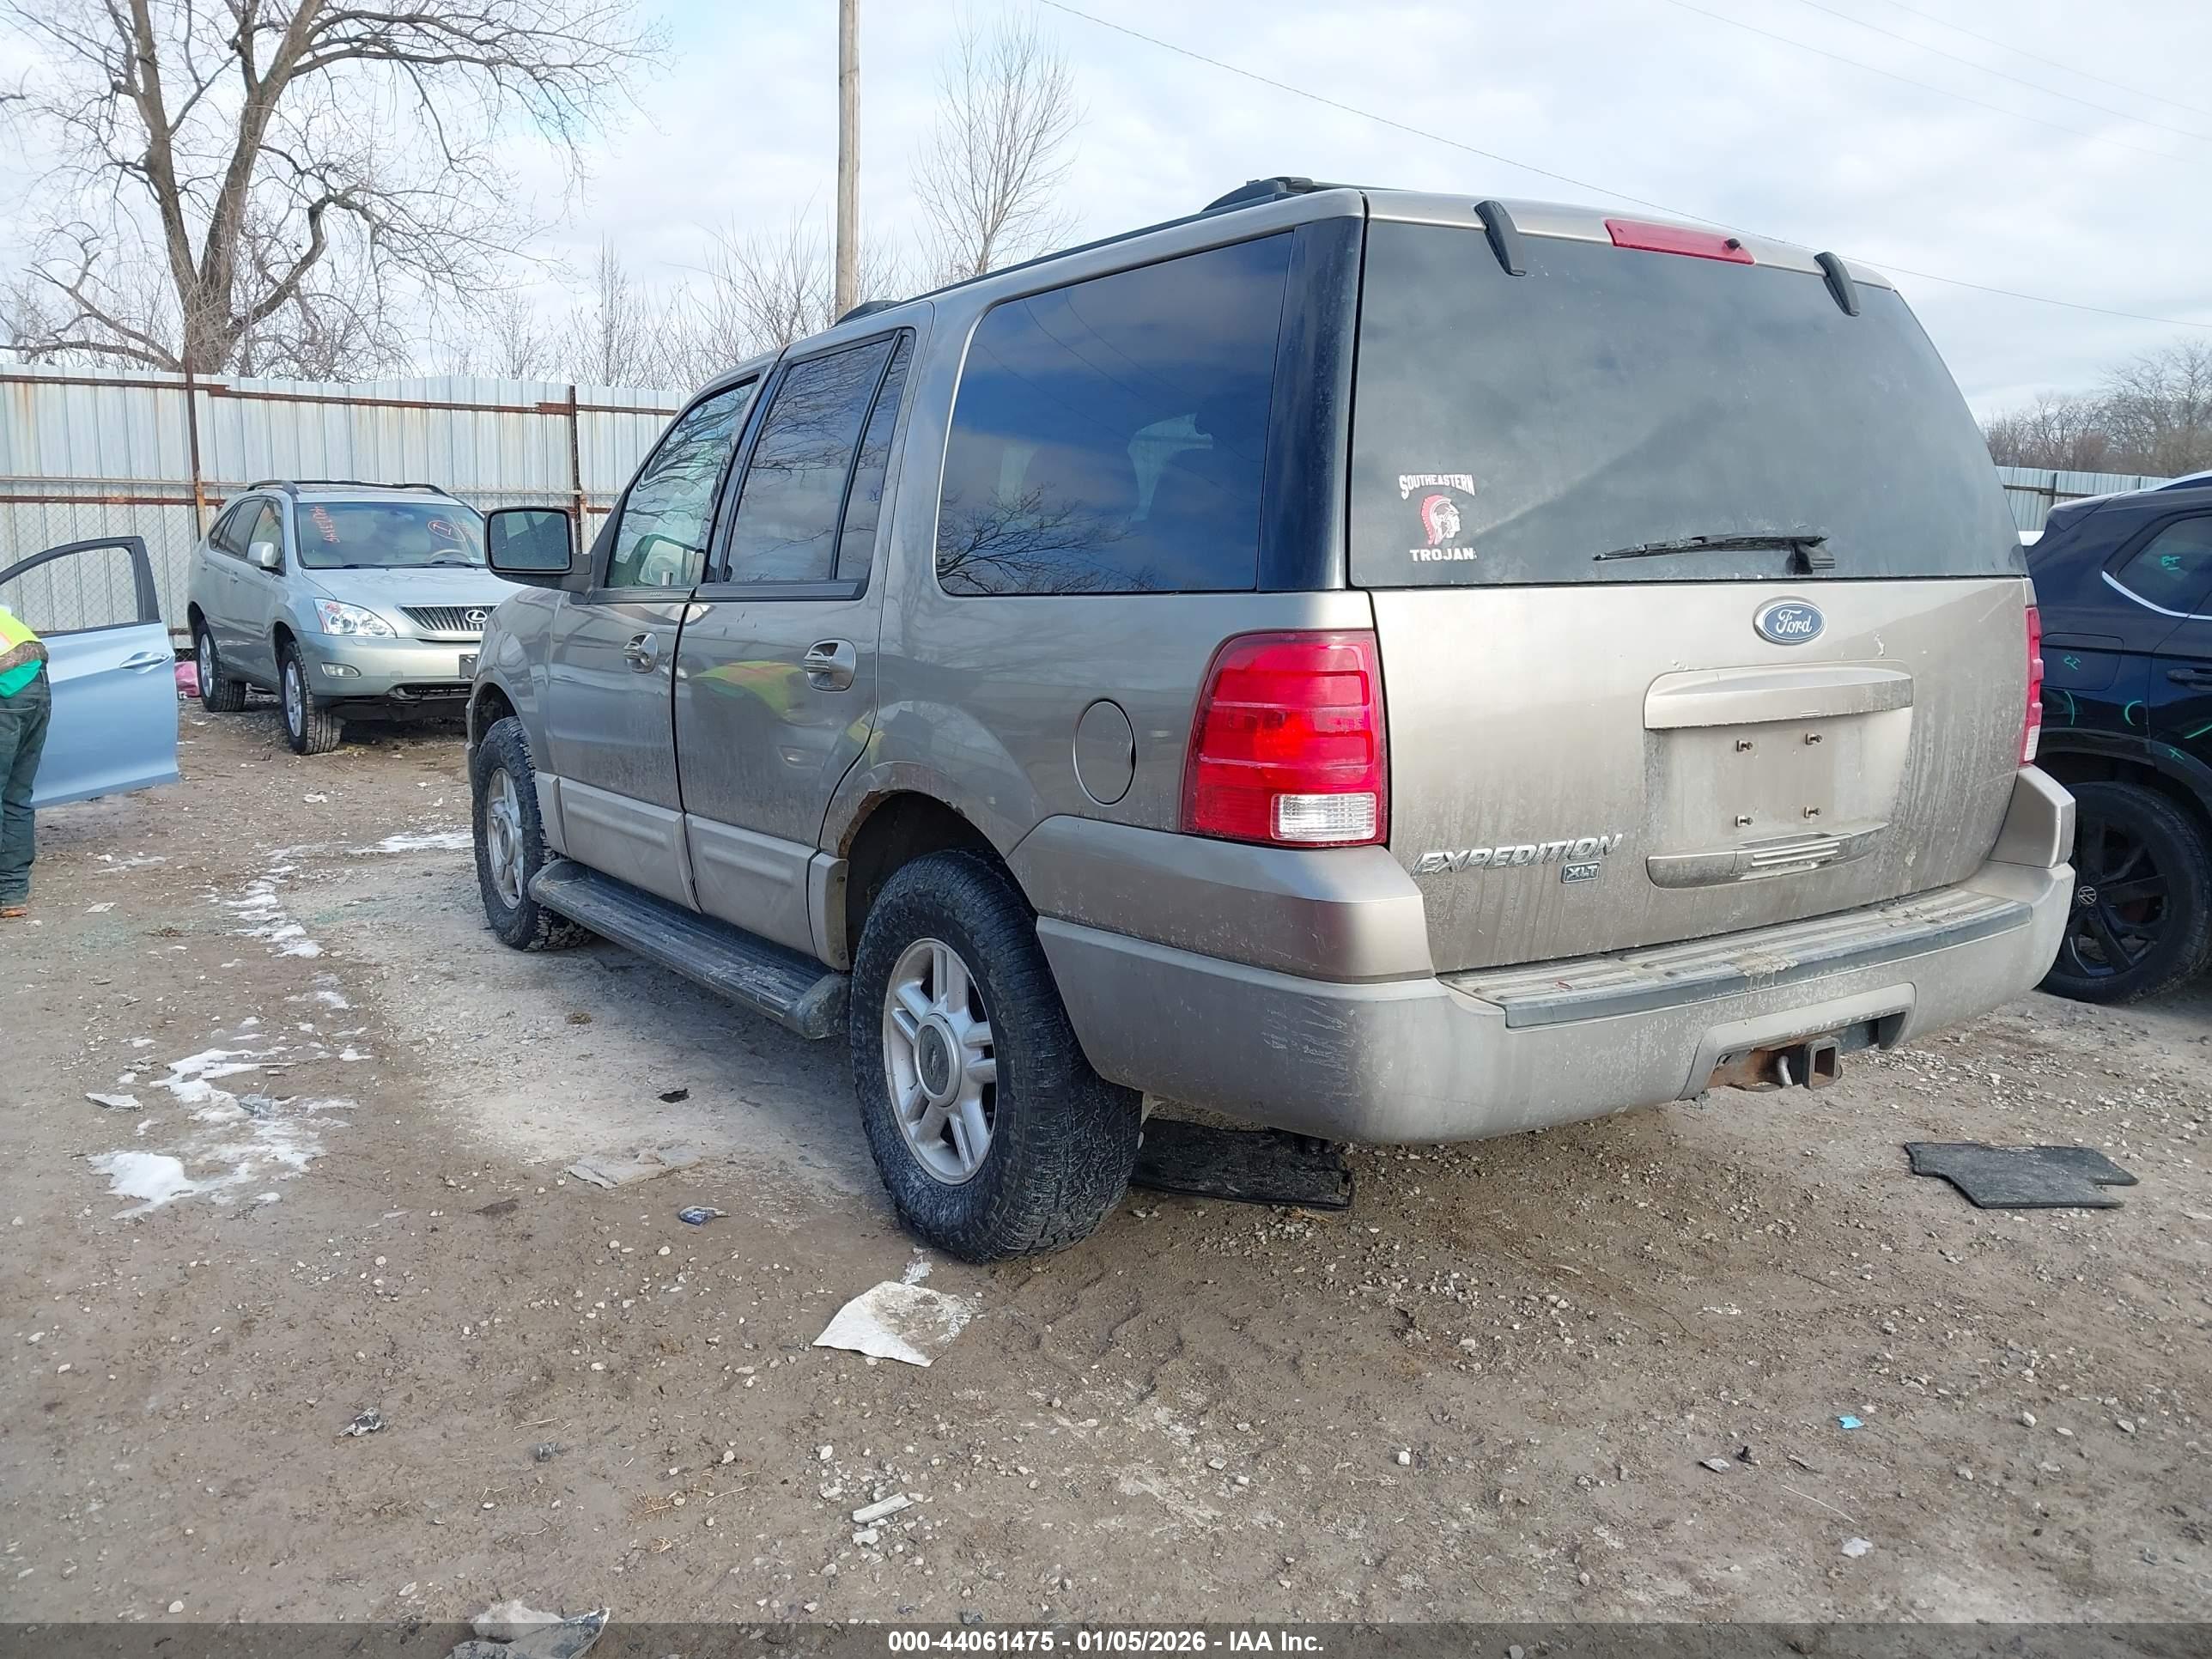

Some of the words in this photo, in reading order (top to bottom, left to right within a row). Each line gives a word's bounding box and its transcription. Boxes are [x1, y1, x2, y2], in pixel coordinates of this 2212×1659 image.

[1398, 474, 1475, 500] SOUTHEASTERN
[1409, 547, 1477, 562] TROJAN
[1776, 609, 1813, 634] Ford
[1413, 834, 1623, 876] EXPEDITION
[1566, 864, 1598, 879] XLT
